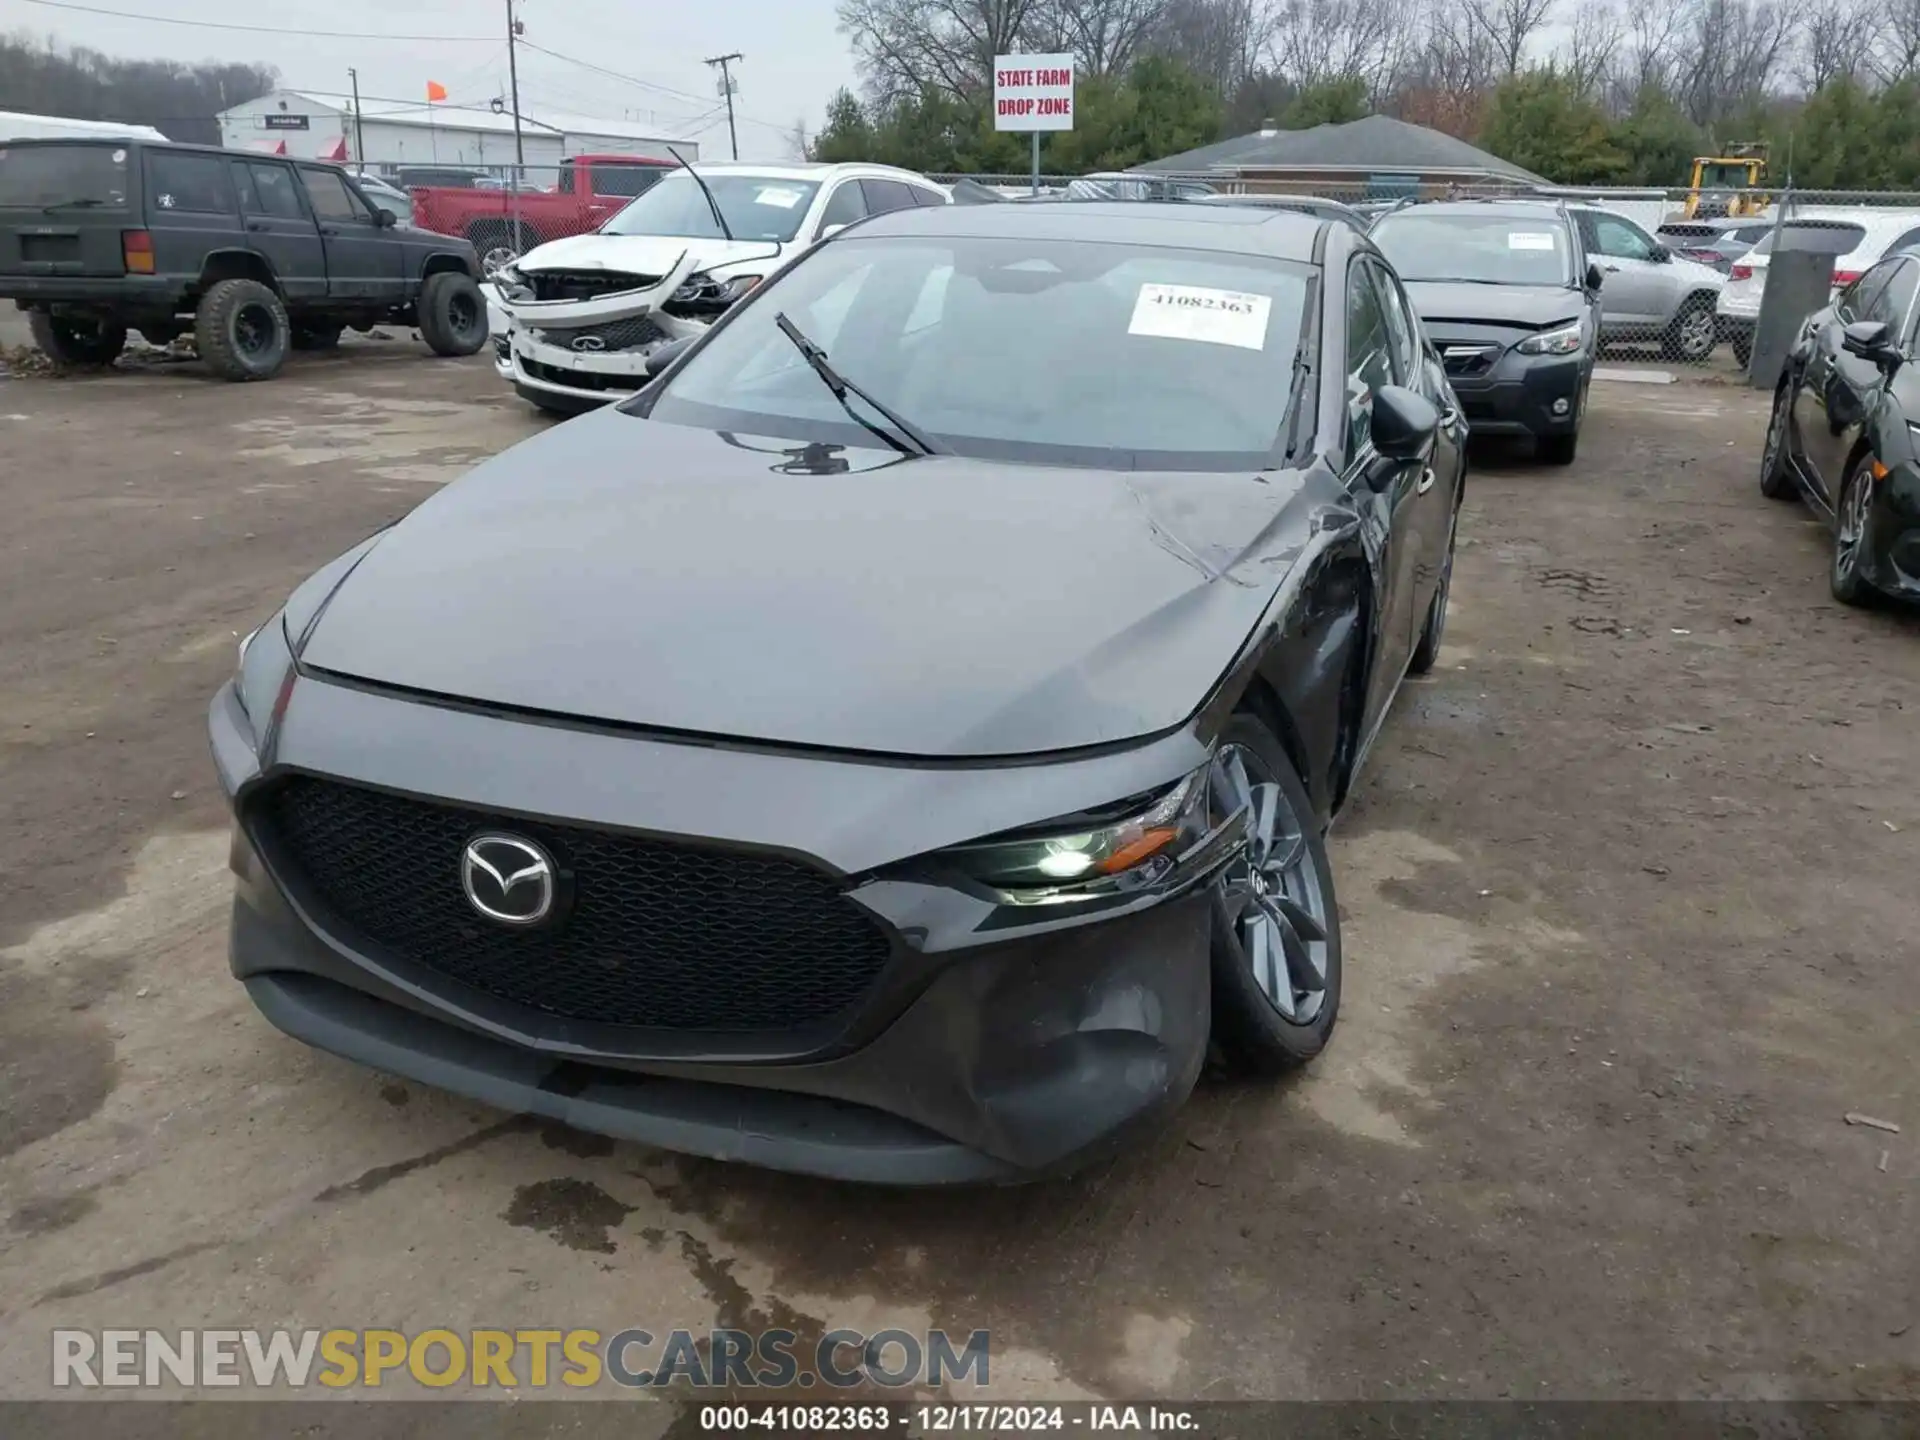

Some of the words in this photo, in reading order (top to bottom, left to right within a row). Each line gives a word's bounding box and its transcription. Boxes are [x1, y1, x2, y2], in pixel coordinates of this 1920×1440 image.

[997, 70, 1033, 87] STATE
[1036, 69, 1070, 86] FARM
[998, 99, 1034, 116] DROP
[1037, 98, 1070, 115] ZONE
[1150, 294, 1253, 314] 41082363
